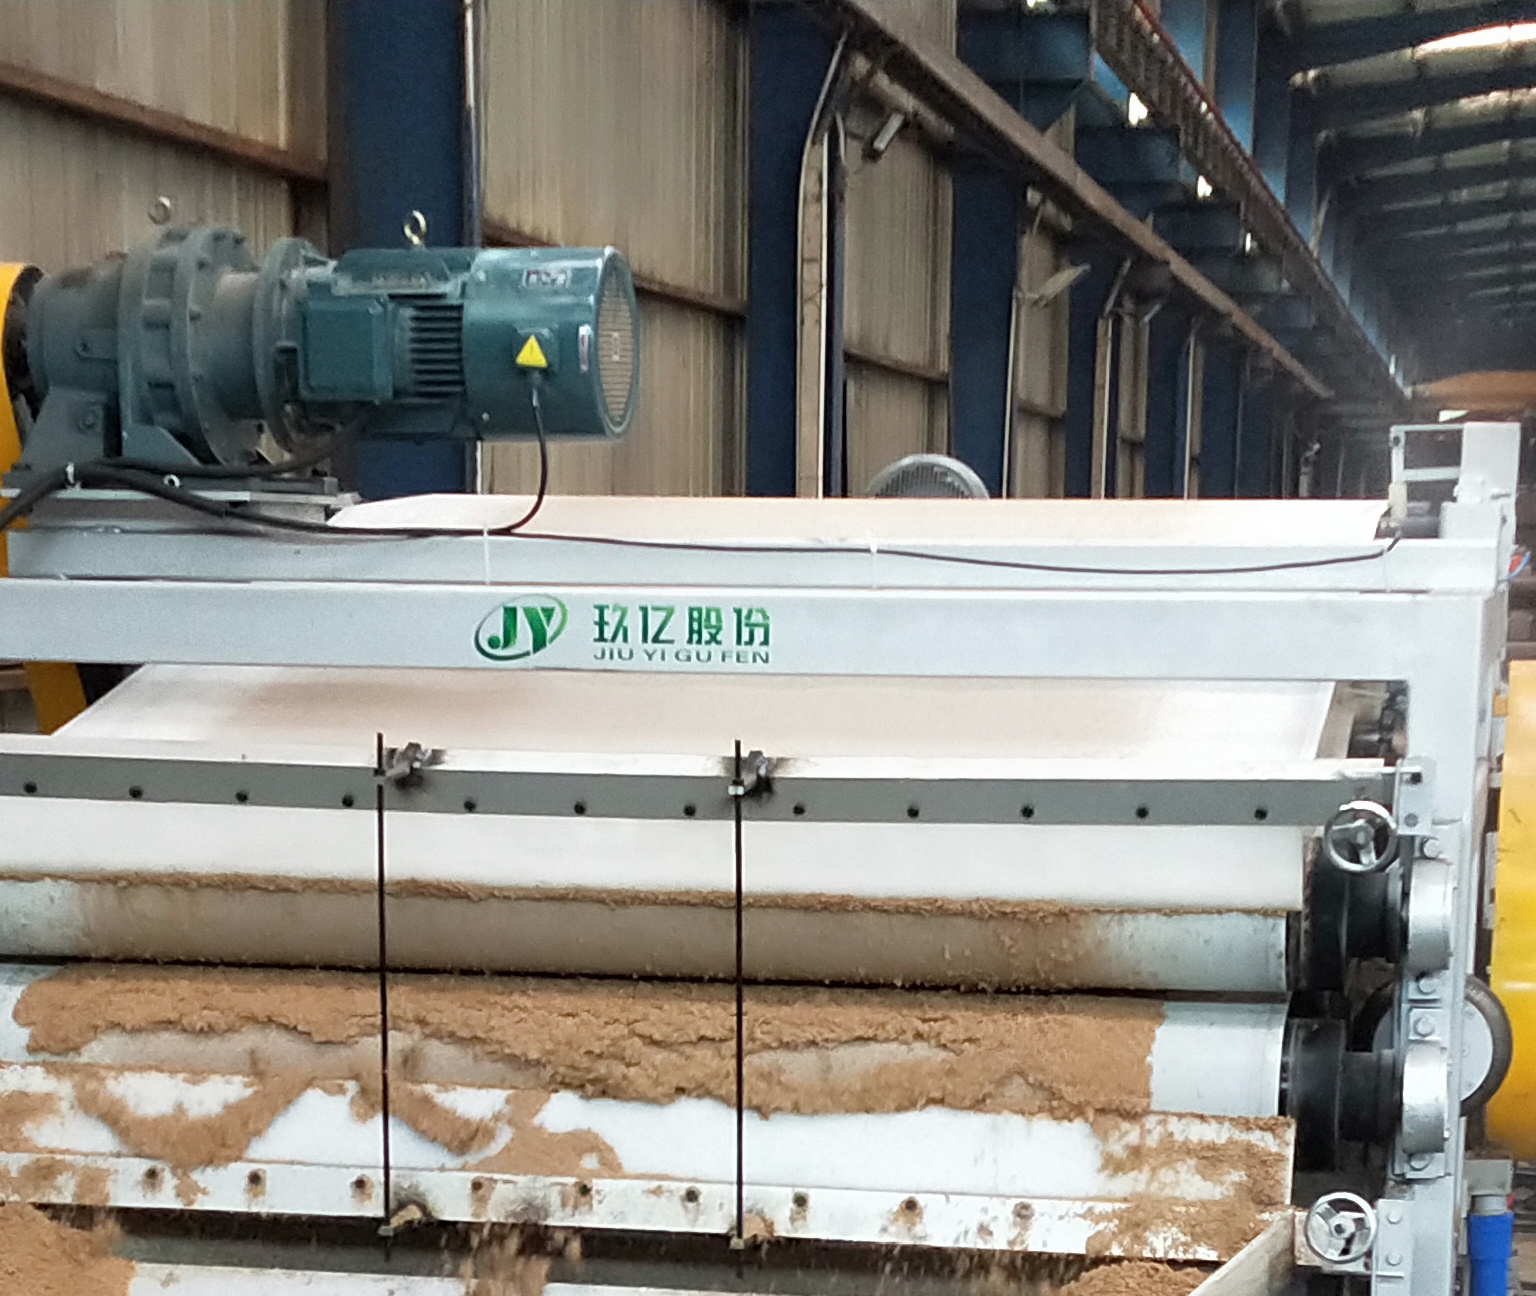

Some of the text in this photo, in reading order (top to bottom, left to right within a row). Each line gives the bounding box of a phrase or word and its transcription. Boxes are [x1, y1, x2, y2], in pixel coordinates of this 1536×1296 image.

[486, 605, 557, 655] JY
[592, 603, 771, 647] 玖亿股份
[593, 648, 770, 664] JIU YI GU FEN
